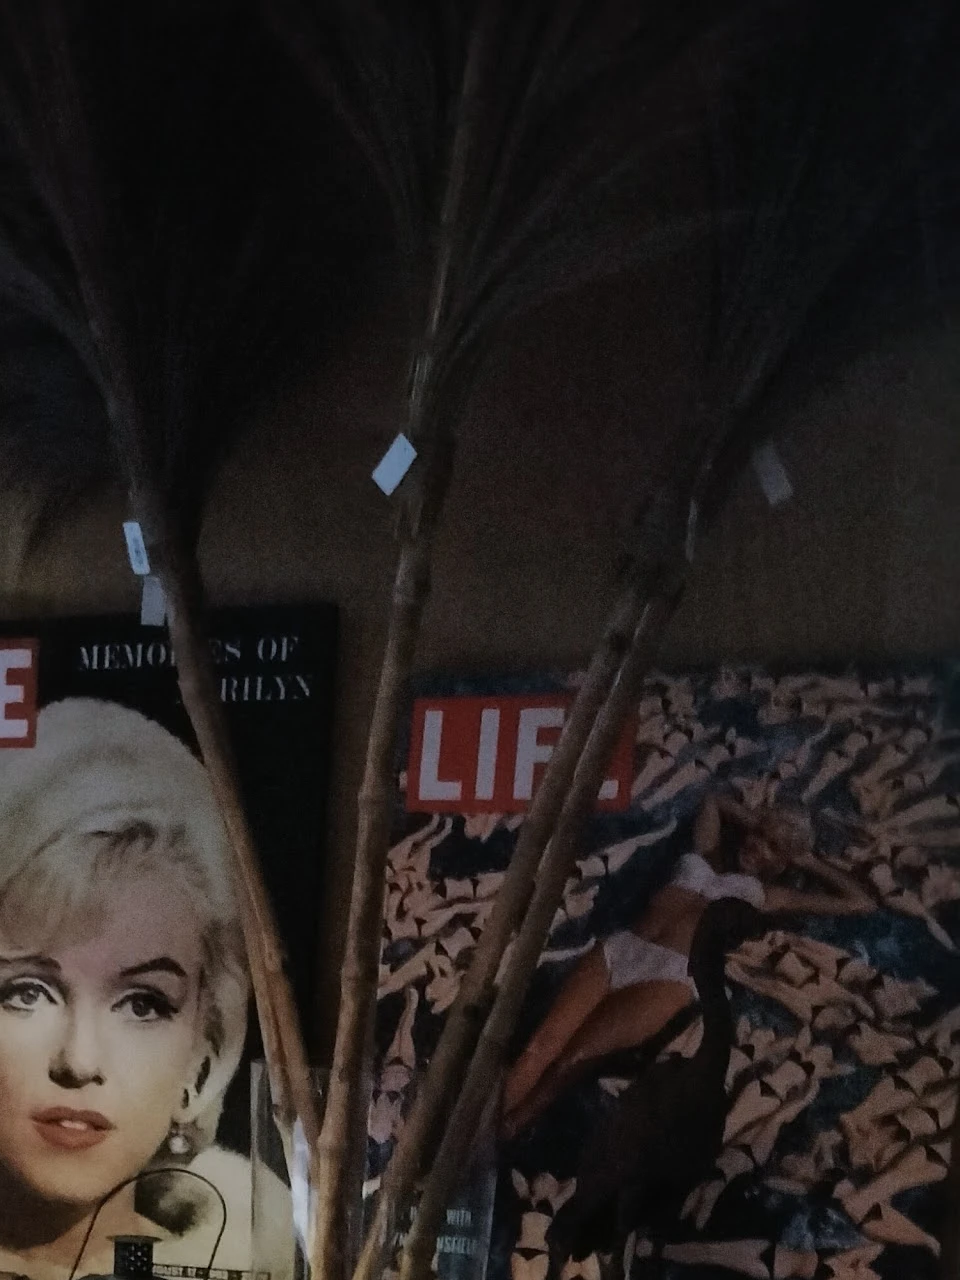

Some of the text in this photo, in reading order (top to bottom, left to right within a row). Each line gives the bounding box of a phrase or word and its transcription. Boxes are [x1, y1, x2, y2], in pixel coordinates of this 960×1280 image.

[256, 634, 300, 662] OF
[219, 673, 313, 703] RILYN
[418, 708, 620, 801] LIF
